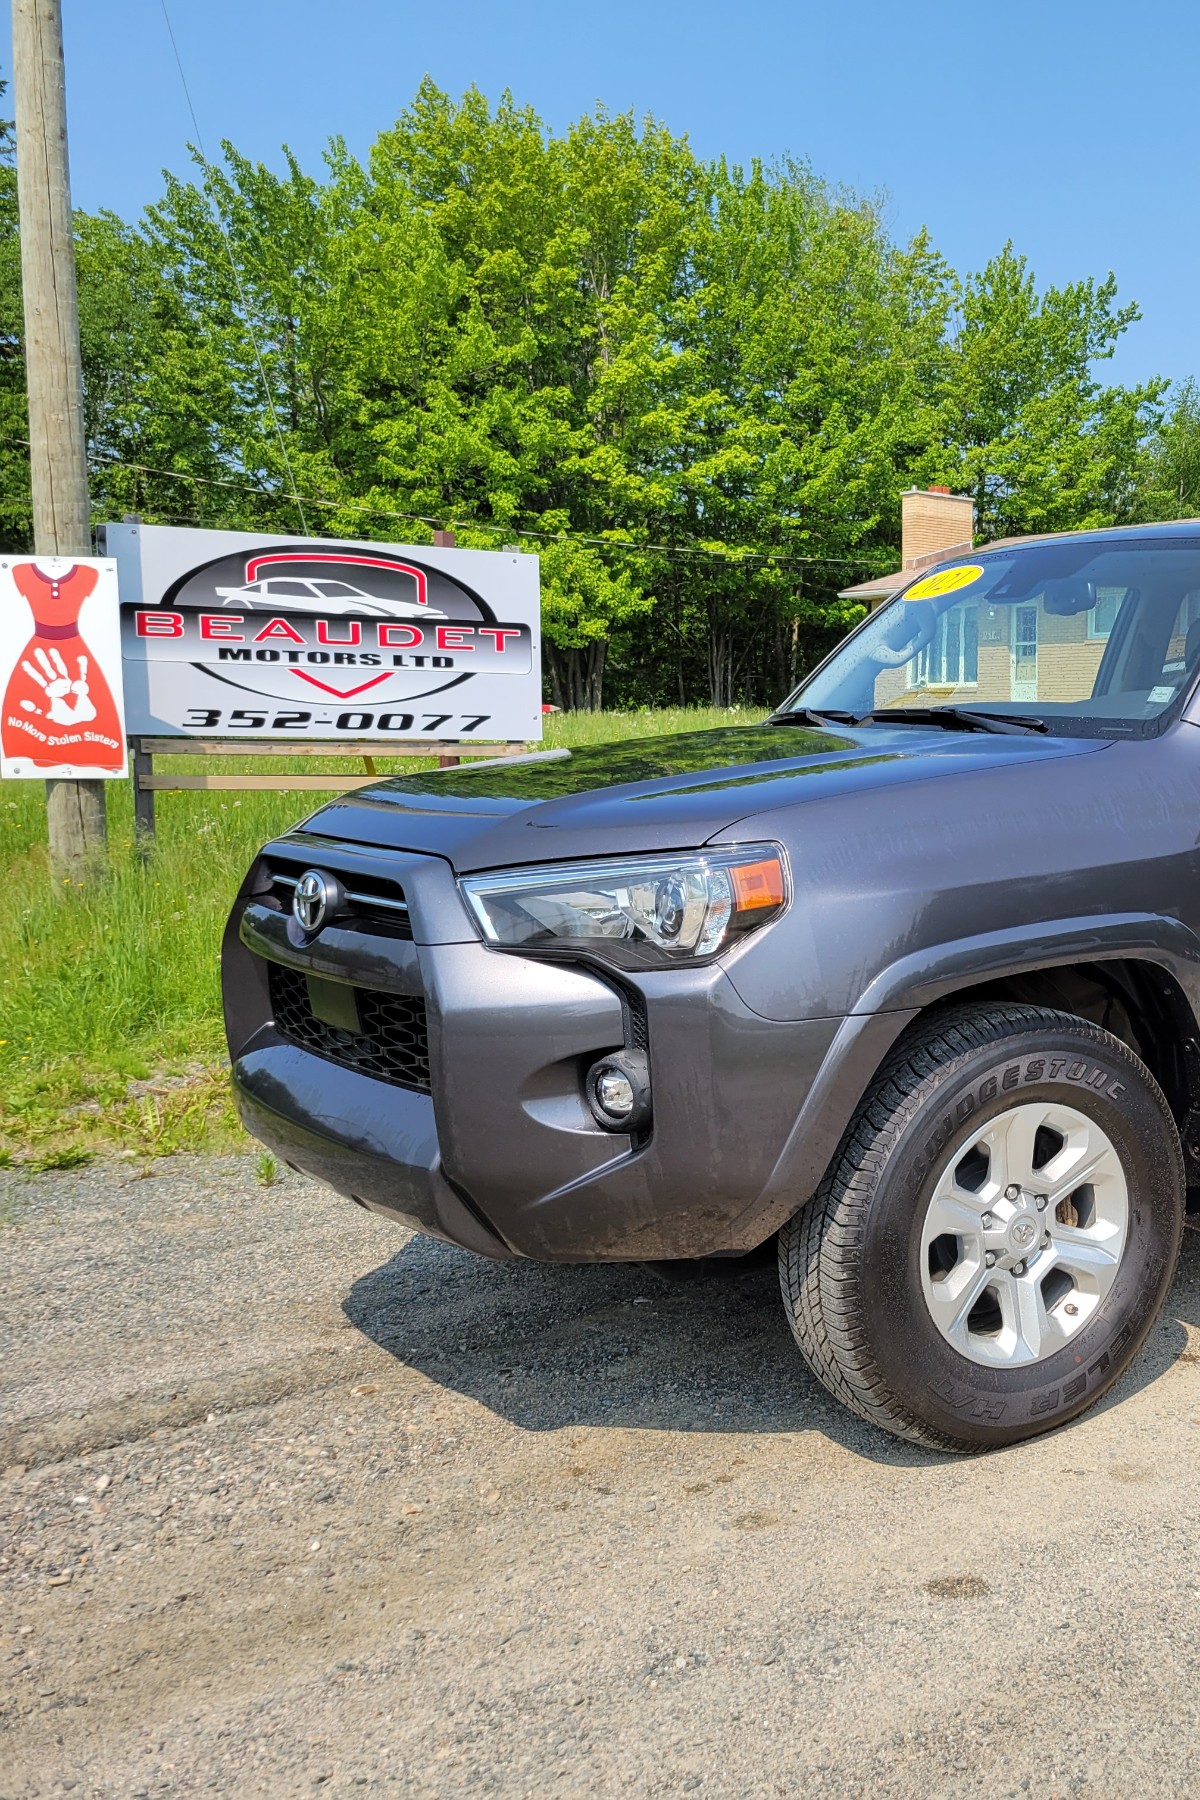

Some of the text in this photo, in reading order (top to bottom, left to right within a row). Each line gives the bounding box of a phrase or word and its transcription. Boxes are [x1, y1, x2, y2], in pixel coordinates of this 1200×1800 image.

[135, 610, 521, 653] BEAUDET
[218, 647, 455, 668] MOTORS LTD
[8, 716, 120, 749] No More Stolen Sisters
[182, 708, 492, 732] 352-0077
